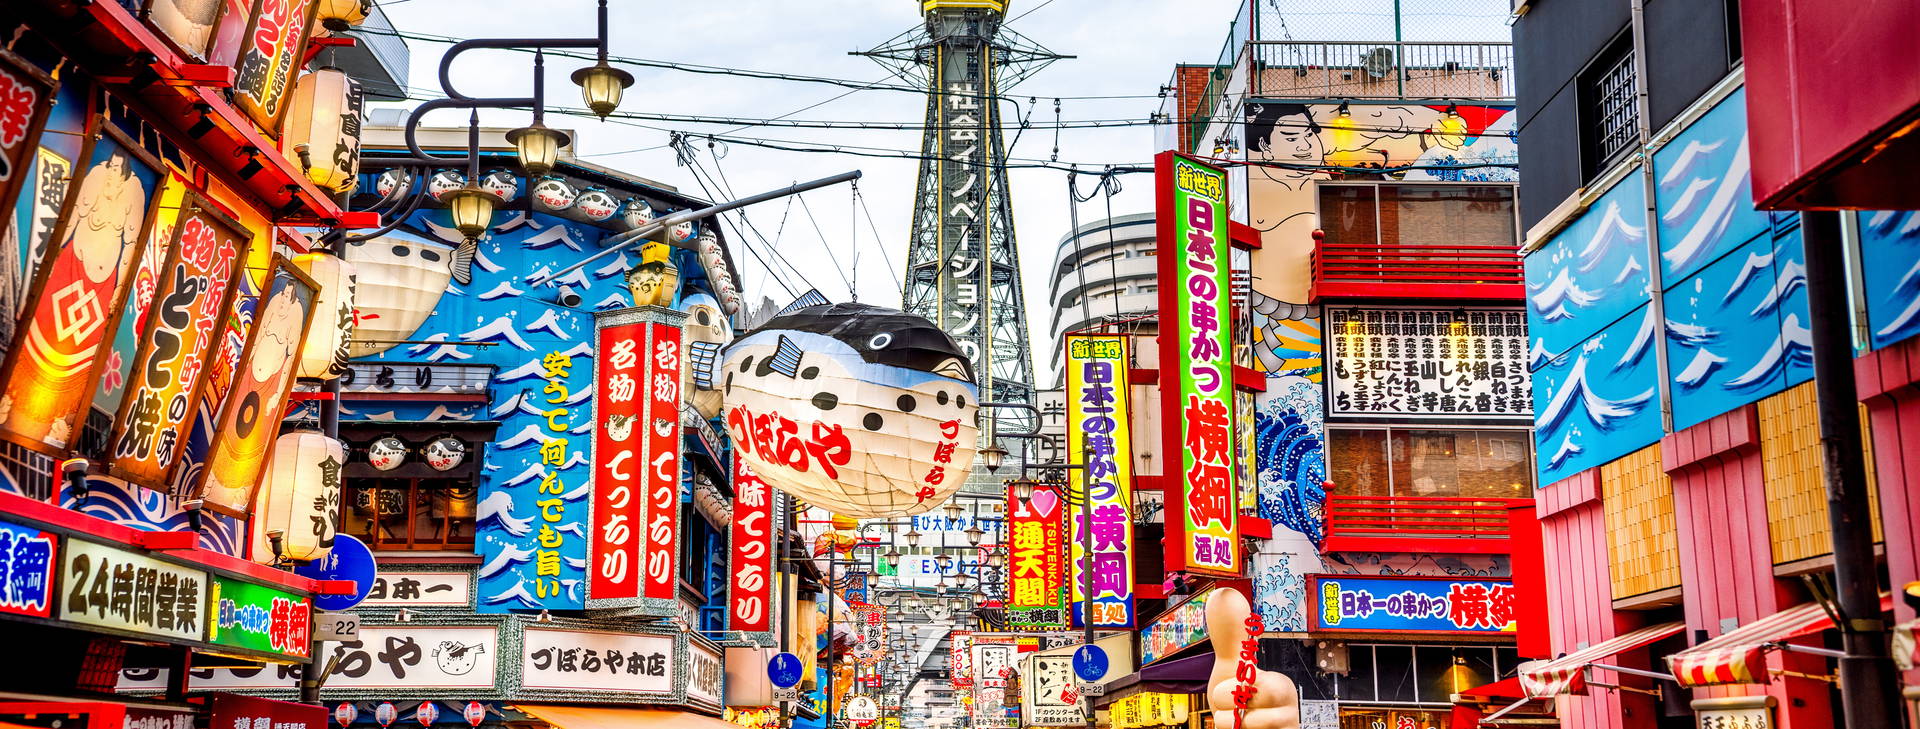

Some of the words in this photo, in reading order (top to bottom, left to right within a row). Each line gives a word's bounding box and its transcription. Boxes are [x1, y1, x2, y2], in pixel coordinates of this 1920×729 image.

[1177, 163, 1222, 200] 新世界
[948, 83, 979, 365] 社会イノベーションの
[1188, 198, 1221, 391] 日本一の串かつ
[1333, 311, 1348, 335] 前頭
[1367, 311, 1383, 335] 前頭
[1385, 311, 1400, 335] 前頭
[1402, 311, 1418, 335] 前頭
[1419, 312, 1435, 336] 前頭
[1436, 312, 1452, 336] 前頭
[1471, 312, 1487, 336] 前頭
[1488, 312, 1504, 336] 前頭
[1505, 312, 1522, 336] 前頭
[156, 240, 237, 468] 大阪下町の味
[608, 338, 637, 403] 名物
[654, 338, 678, 403] 名物
[1072, 340, 1122, 359] 新世界
[1335, 360, 1351, 412] もち
[1369, 360, 1387, 412] 紅しょうが
[1386, 360, 1404, 412] にんにく
[1404, 360, 1424, 412] 玉ねぎ
[1421, 360, 1438, 412] 山芋
[1439, 360, 1456, 412] しし唐
[1456, 360, 1474, 412] れんこん
[1473, 360, 1491, 412] 銀杏
[1491, 360, 1509, 412] 白ねぎ
[1508, 360, 1527, 412] さつま芋
[728, 404, 851, 479] づぼらや
[1081, 361, 1117, 501] 日本一の串かつ
[537, 353, 572, 598] 安うて何んでも旨い
[915, 417, 961, 503] づぼらや
[1184, 397, 1232, 529] 横綱
[601, 450, 632, 584] てっちり
[648, 451, 675, 585] てっちり
[1013, 520, 1045, 606] 通天閣
[1047, 521, 1057, 606] TSUTENKAKU
[1075, 504, 1128, 599] 横綱
[1195, 536, 1231, 567] 酒処
[69, 554, 198, 634] 24時間営業
[368, 577, 453, 600] 日本一
[1082, 603, 1126, 624] 酒処
[1324, 583, 1339, 624] 新世界
[1342, 592, 1446, 617] 日本一の串かつ
[270, 597, 309, 654] 横綱
[866, 612, 880, 650] 串かつ
[1029, 609, 1058, 623] 横綱
[530, 647, 666, 682] づぼらや本店
